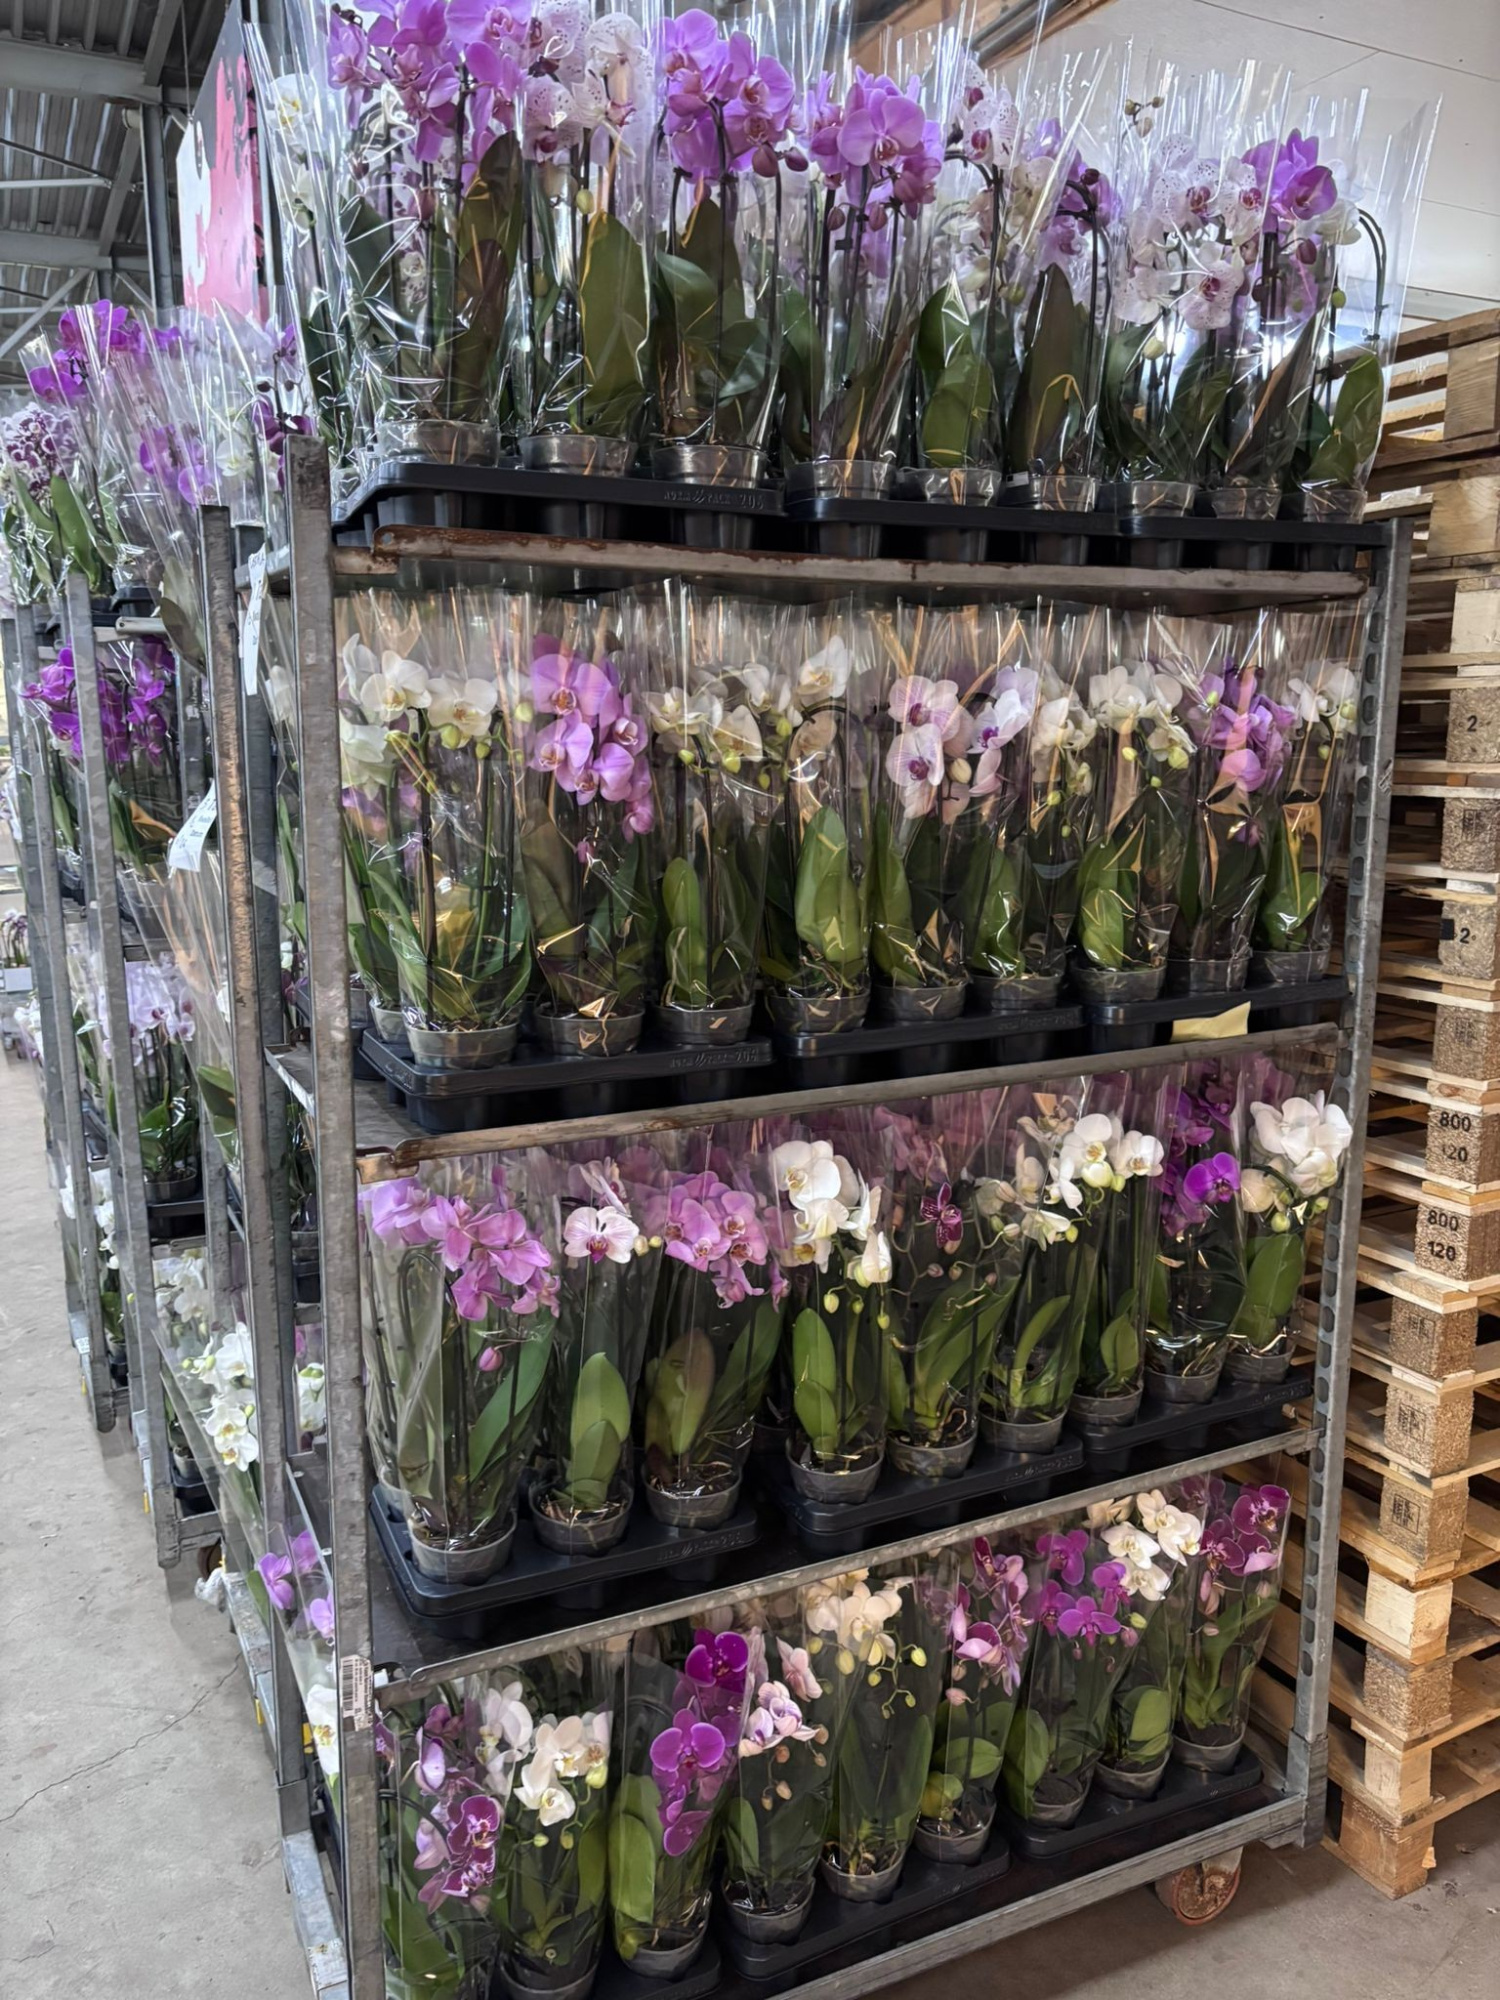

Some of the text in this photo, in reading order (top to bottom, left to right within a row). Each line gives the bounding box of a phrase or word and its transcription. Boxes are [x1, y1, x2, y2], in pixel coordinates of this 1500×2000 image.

[1467, 714, 1478, 732] 2
[1459, 927, 1471, 944] 2
[1440, 1111, 1472, 1132] 800
[1428, 1209, 1459, 1232] 800
[1427, 1241, 1456, 1261] 120
